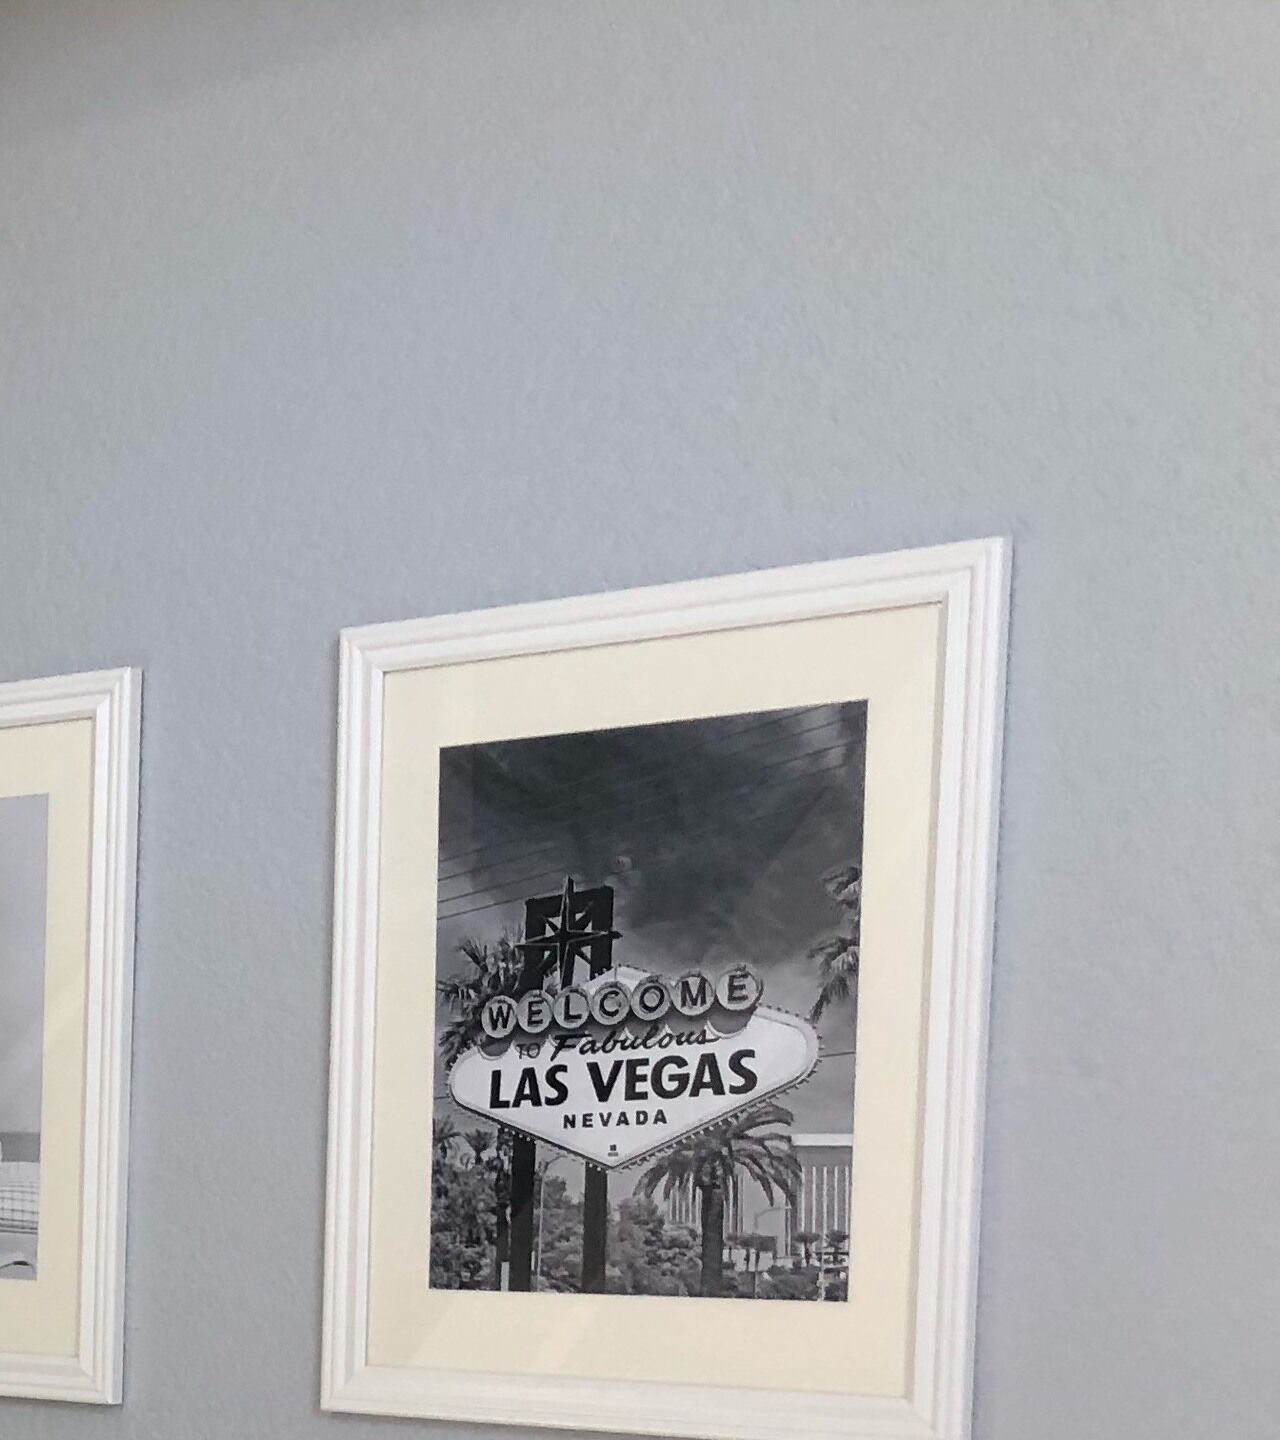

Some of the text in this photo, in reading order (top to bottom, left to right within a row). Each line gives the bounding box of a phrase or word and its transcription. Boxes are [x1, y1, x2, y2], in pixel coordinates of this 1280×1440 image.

[486, 970, 752, 1033] WELCOME
[515, 1023, 718, 1061] TO Fabulous
[490, 1049, 758, 1109] LAS VEGAS
[563, 1110, 668, 1130] NEVADA
